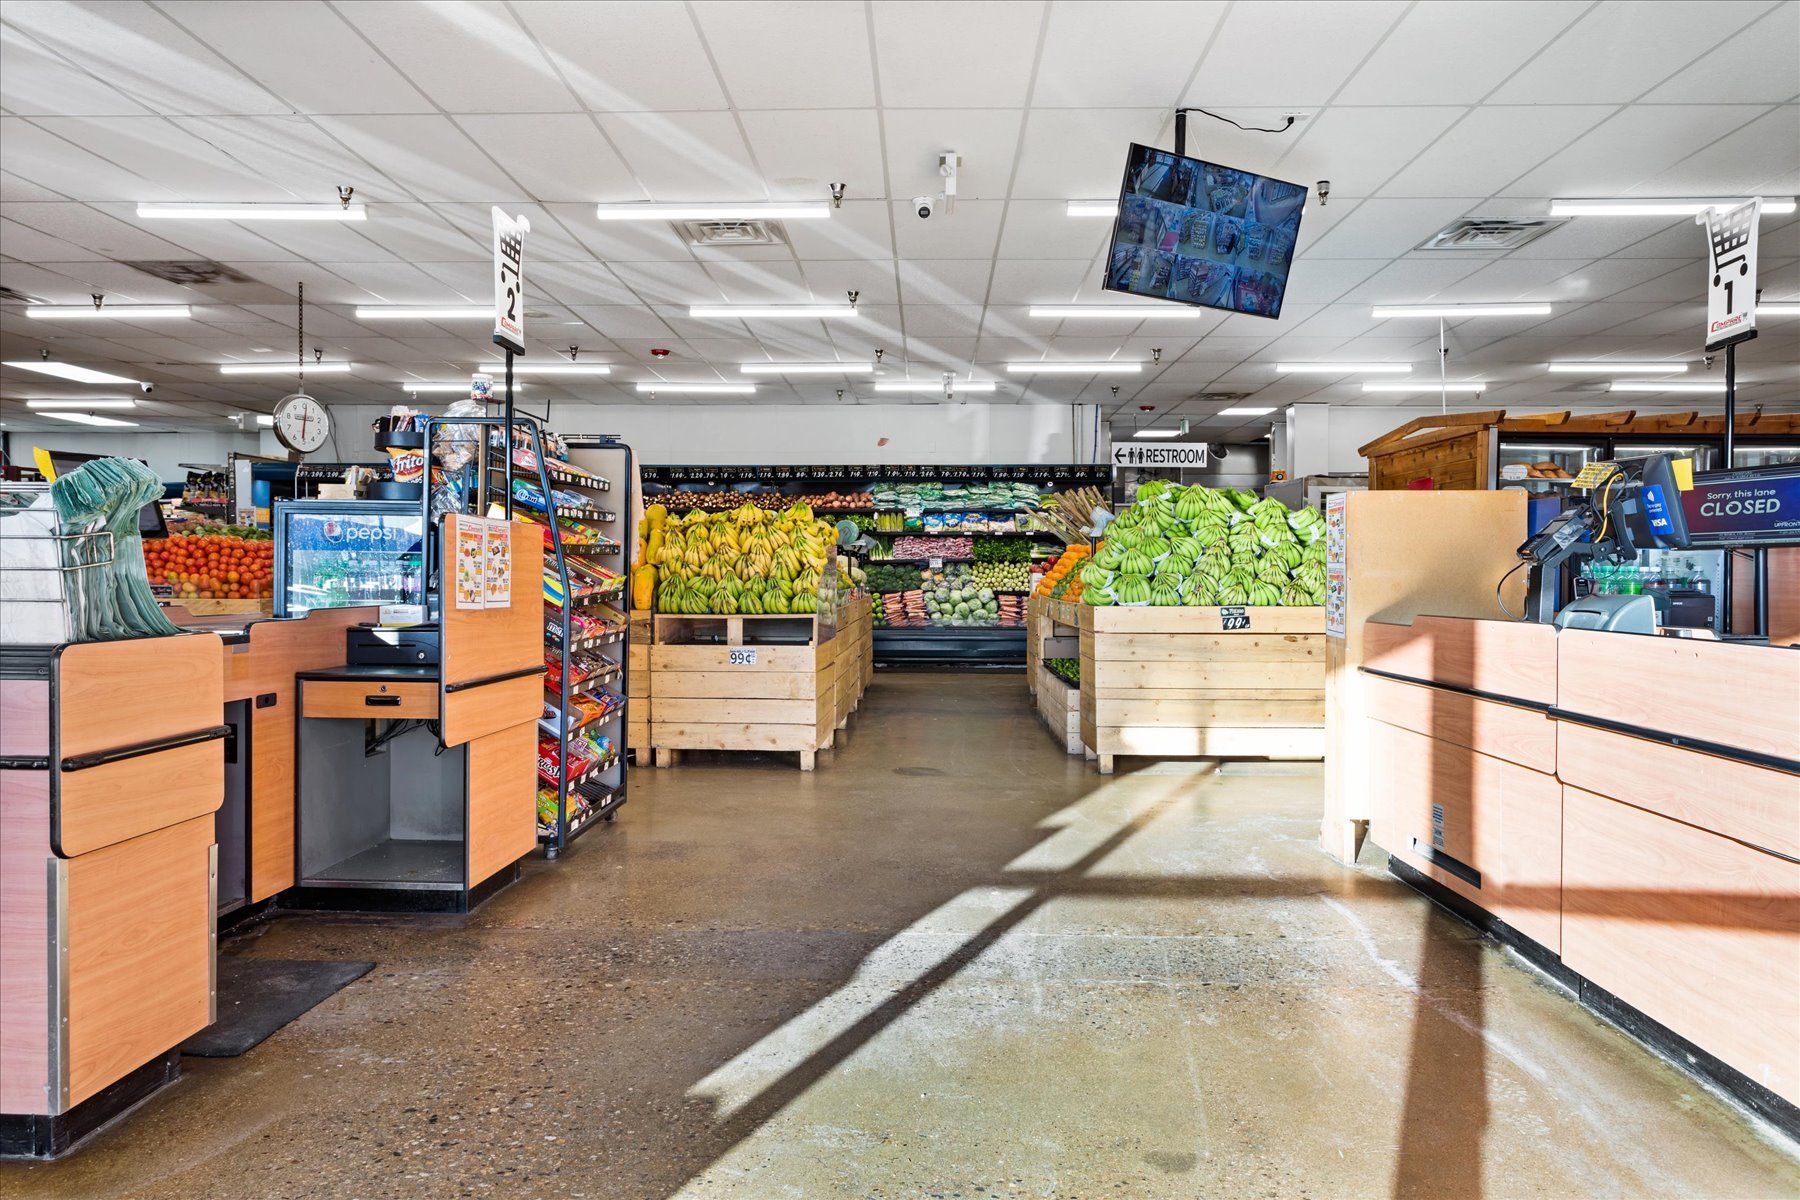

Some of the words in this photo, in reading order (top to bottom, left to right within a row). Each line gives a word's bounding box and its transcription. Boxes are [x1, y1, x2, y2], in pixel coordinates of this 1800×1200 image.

[507, 287, 516, 322] 2
[1724, 280, 1733, 315] 1
[1146, 449, 1205, 463] RESTROOM
[1734, 489, 1752, 498] this
[1754, 488, 1776, 497] lane
[1700, 498, 1781, 517] CLOSED
[1651, 518, 1668, 527] VISA
[346, 526, 397, 543] pepsi
[730, 652, 752, 664] 99¢
